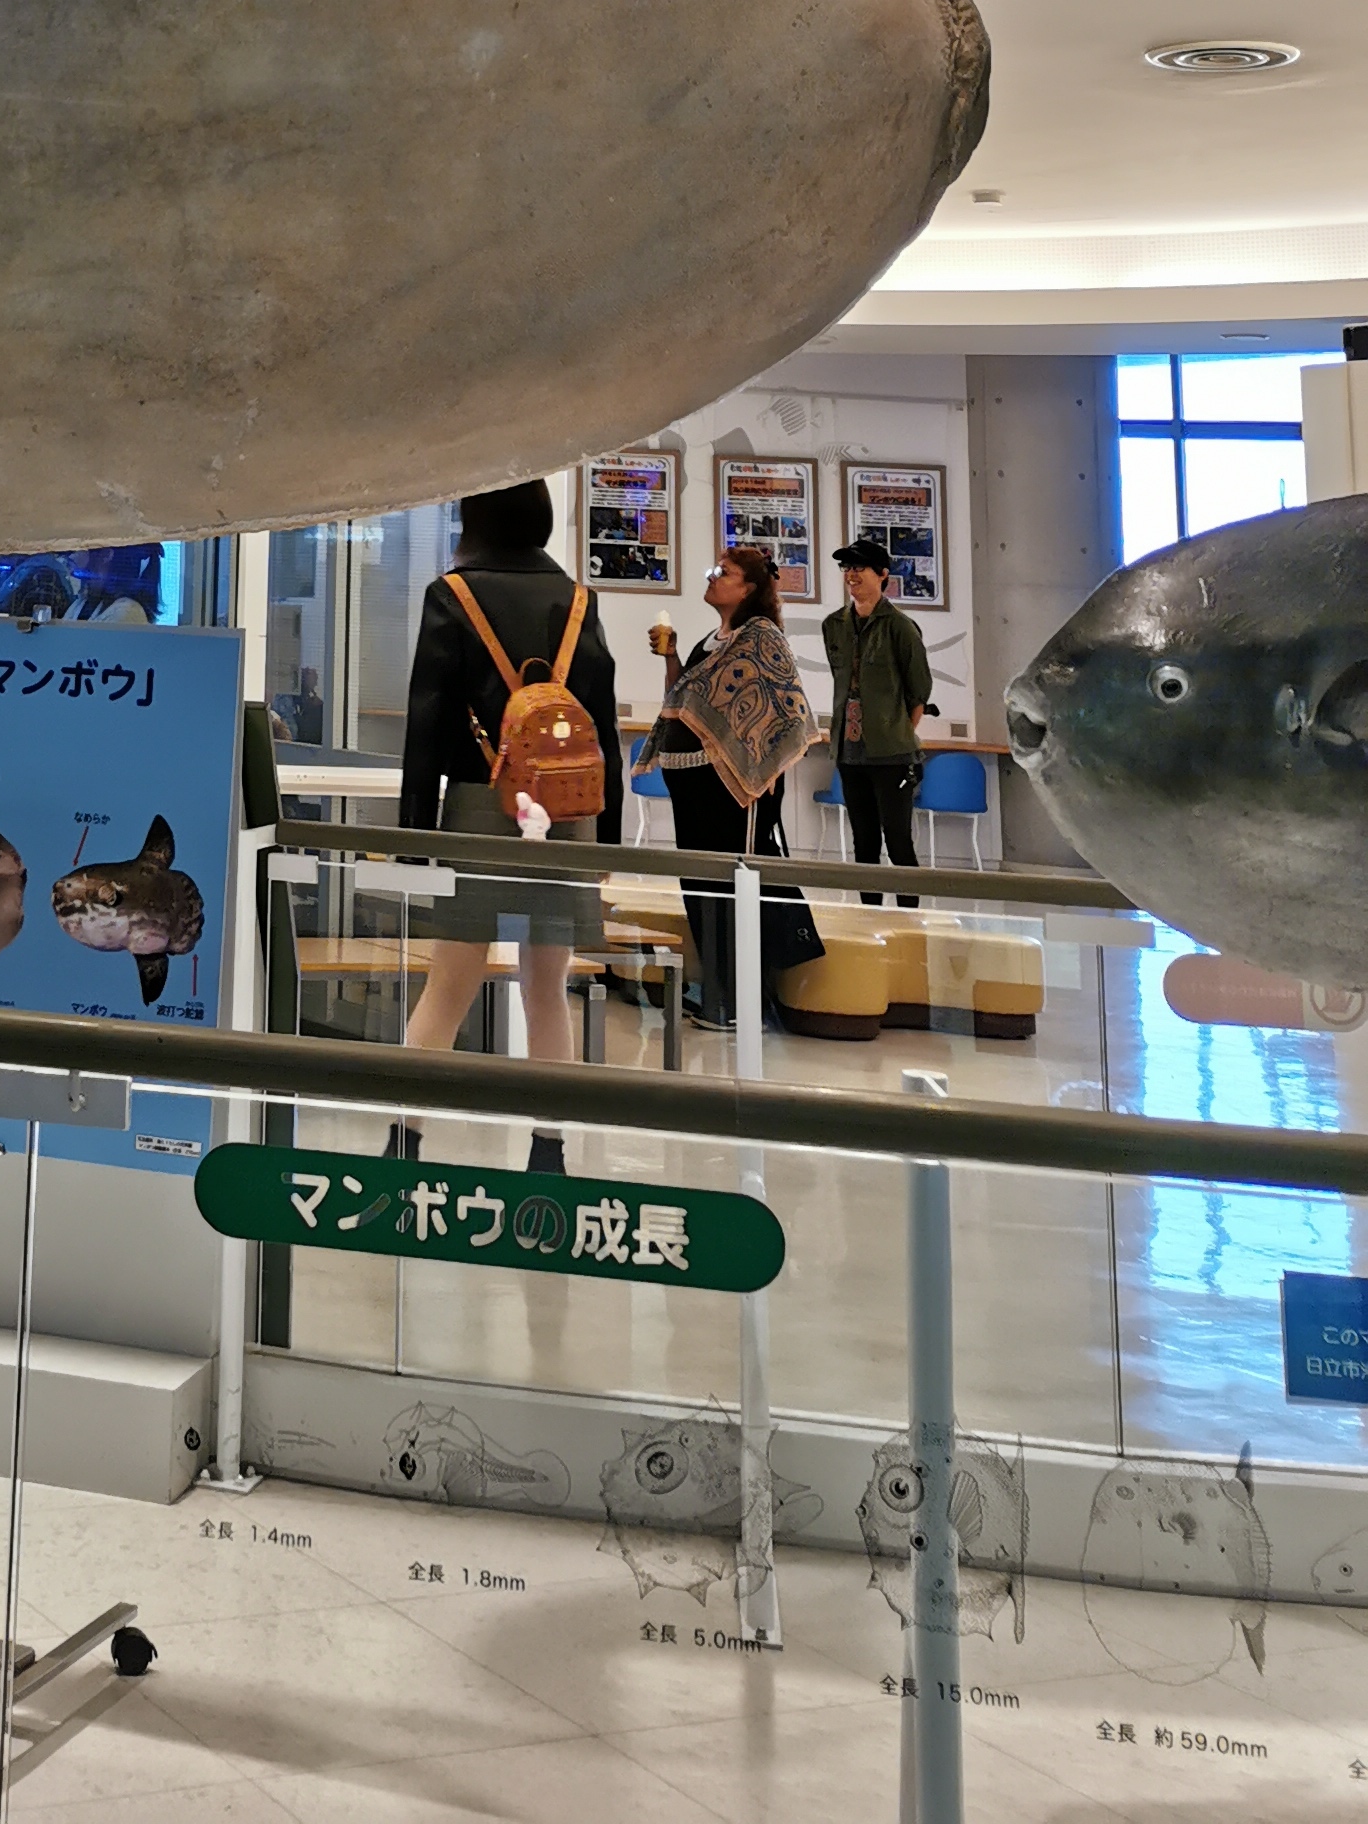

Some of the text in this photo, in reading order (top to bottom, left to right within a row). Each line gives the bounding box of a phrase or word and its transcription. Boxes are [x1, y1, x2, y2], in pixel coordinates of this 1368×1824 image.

[281, 1171, 689, 1270] マンボウの成長
[199, 1518, 312, 1549] 全長 1.4mm
[408, 1561, 526, 1592] 全長 1.8mm
[639, 1621, 762, 1653] 全長 5.0mm
[879, 1674, 1020, 1709] 全長 15.0mm
[1096, 1717, 1137, 1745] 全長
